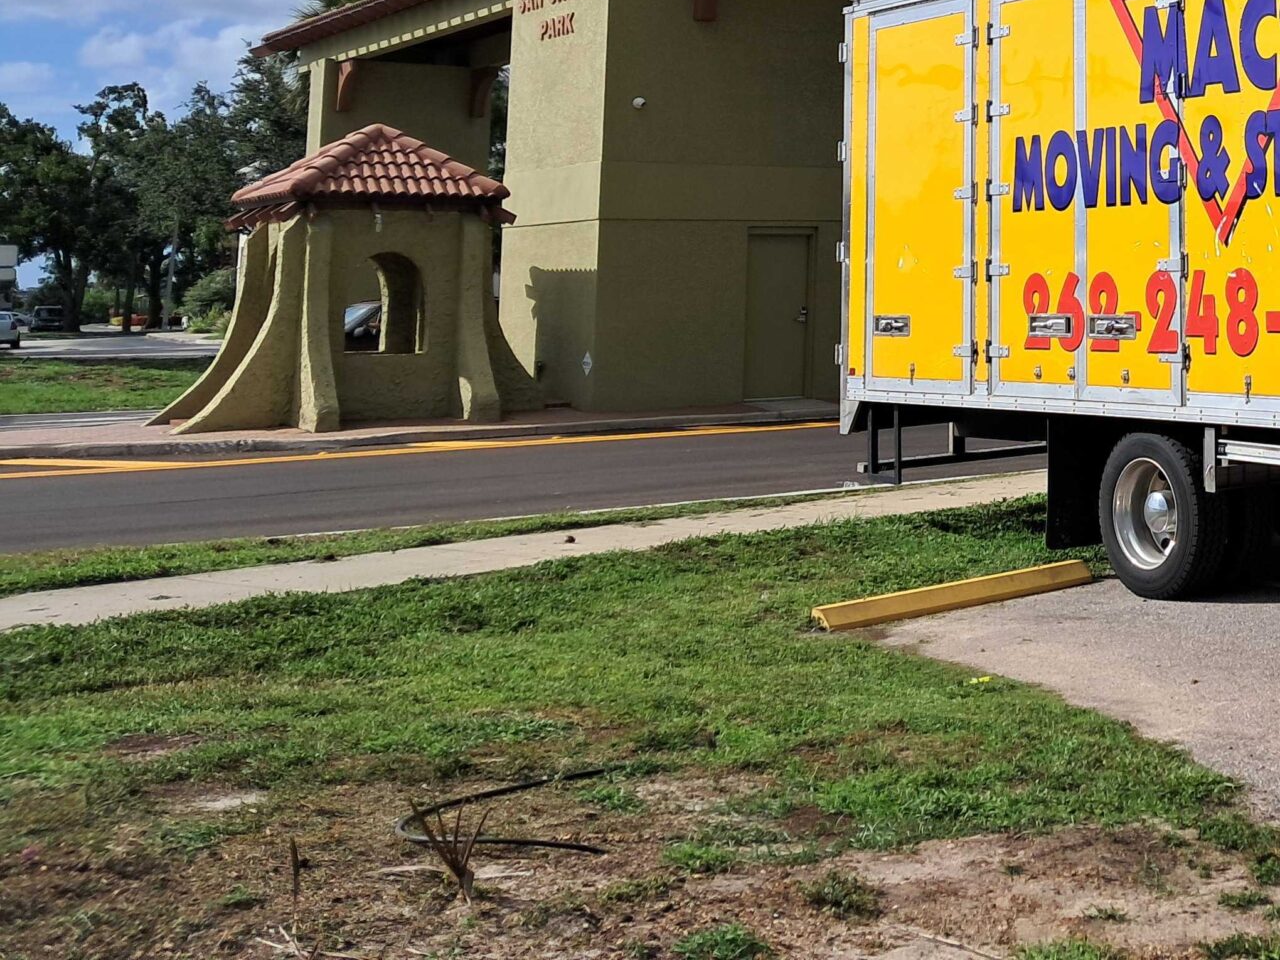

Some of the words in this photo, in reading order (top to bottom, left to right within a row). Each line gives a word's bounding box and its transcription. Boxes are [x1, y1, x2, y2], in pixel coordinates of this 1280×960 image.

[540, 12, 575, 40] PARK
[1012, 119, 1182, 212] MOVING
[1199, 114, 1231, 200] &
